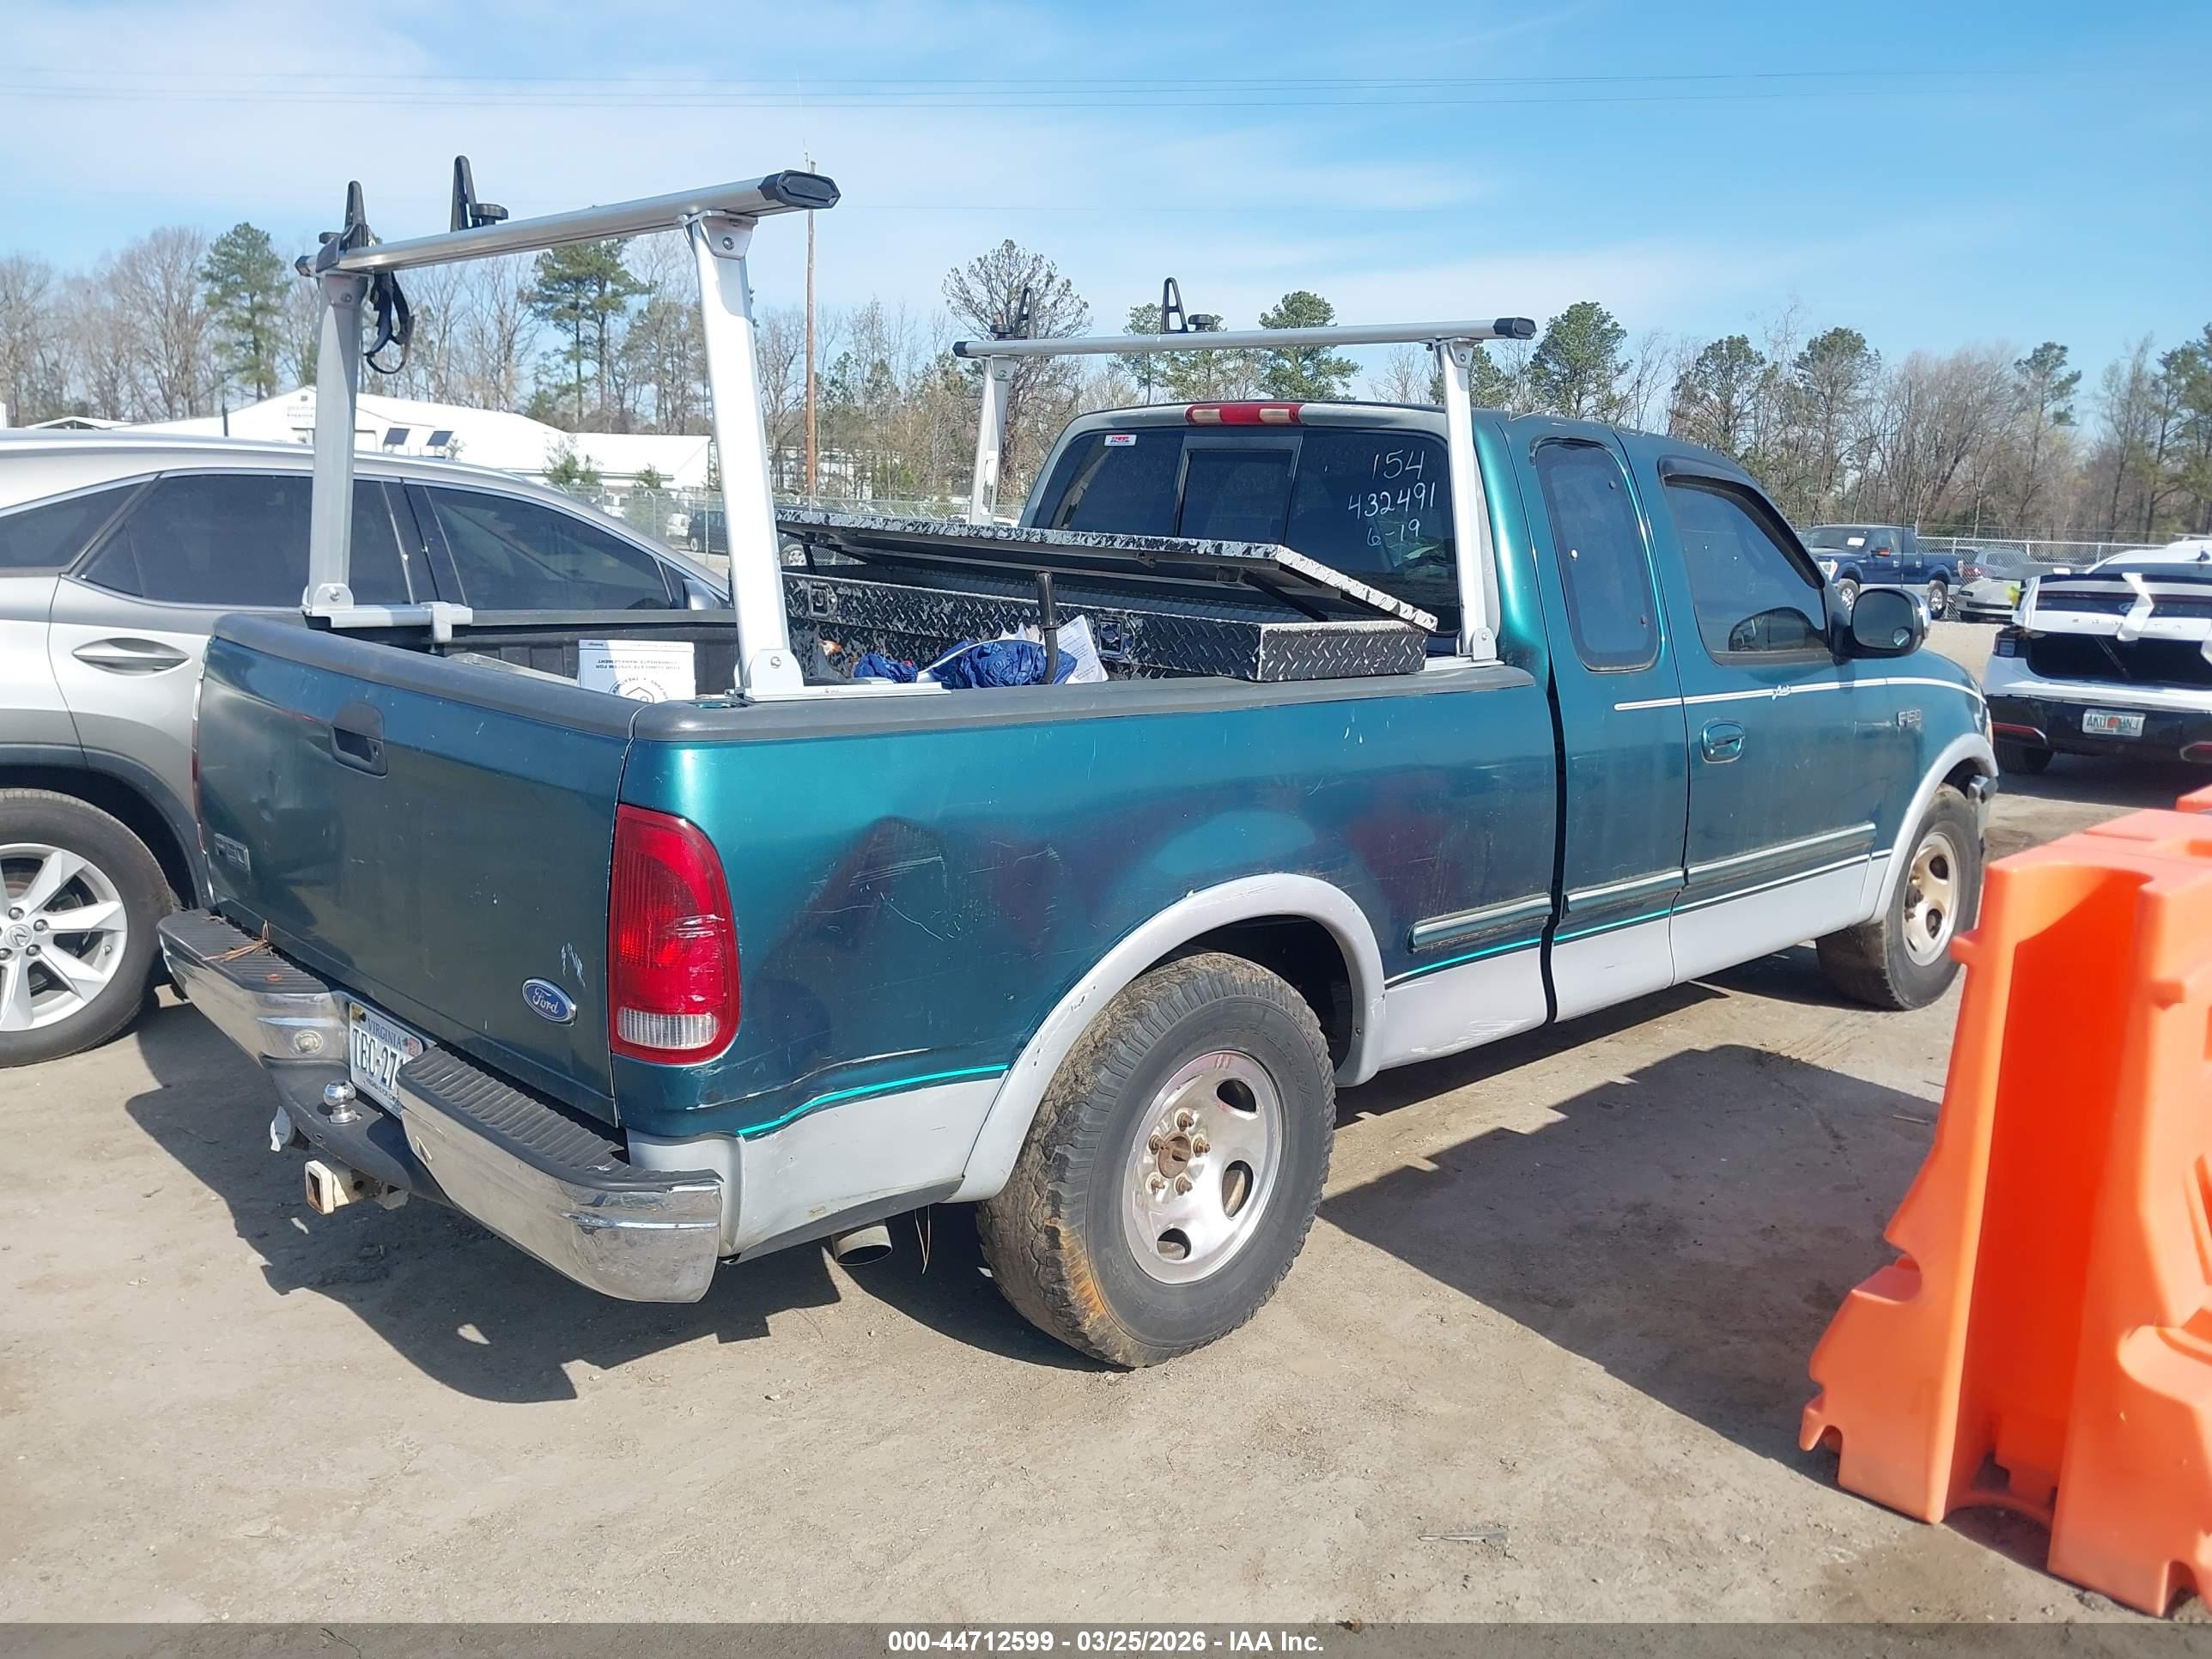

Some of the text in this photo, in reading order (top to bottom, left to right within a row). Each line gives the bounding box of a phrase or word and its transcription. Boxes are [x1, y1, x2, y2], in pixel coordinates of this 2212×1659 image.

[1372, 449, 1425, 480] 154
[1348, 482, 1436, 520] 432491
[1367, 519, 1420, 547] 6-19
[532, 987, 559, 1014] Ford
[367, 1017, 402, 1051] VIRGINIA
